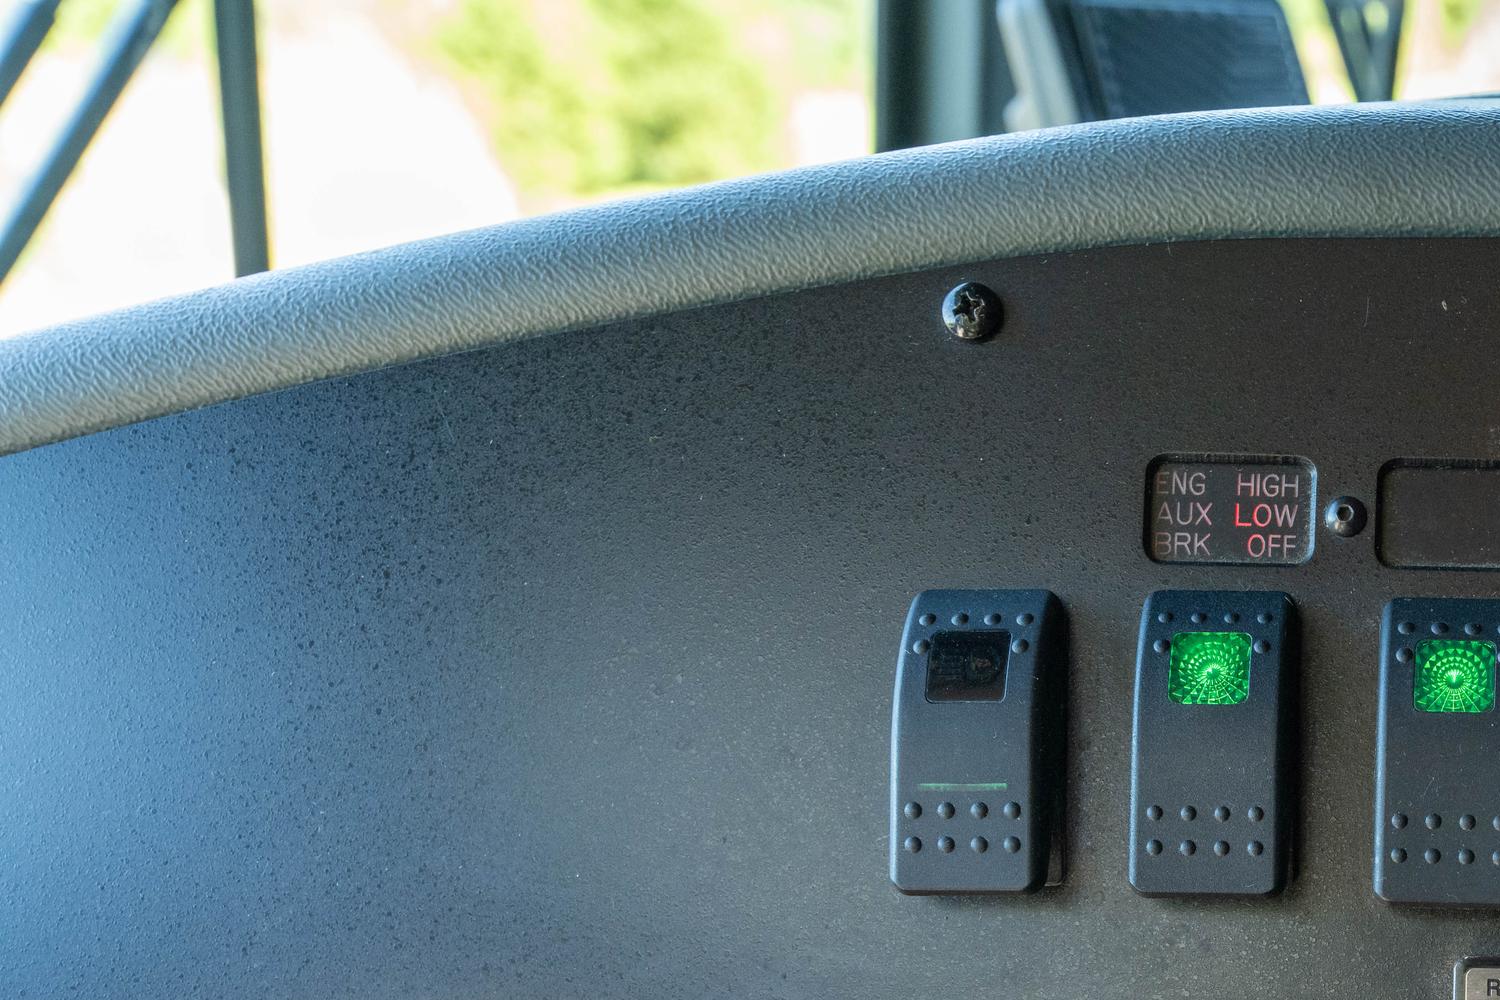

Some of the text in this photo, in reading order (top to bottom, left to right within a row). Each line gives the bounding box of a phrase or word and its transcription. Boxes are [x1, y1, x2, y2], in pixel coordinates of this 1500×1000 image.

[1156, 471, 1206, 496] ENG
[1237, 473, 1299, 498] HIGH
[1157, 501, 1213, 526] AUX
[1235, 502, 1298, 528] LOW
[1154, 532, 1211, 556] BRK
[1247, 533, 1296, 558] OFF
